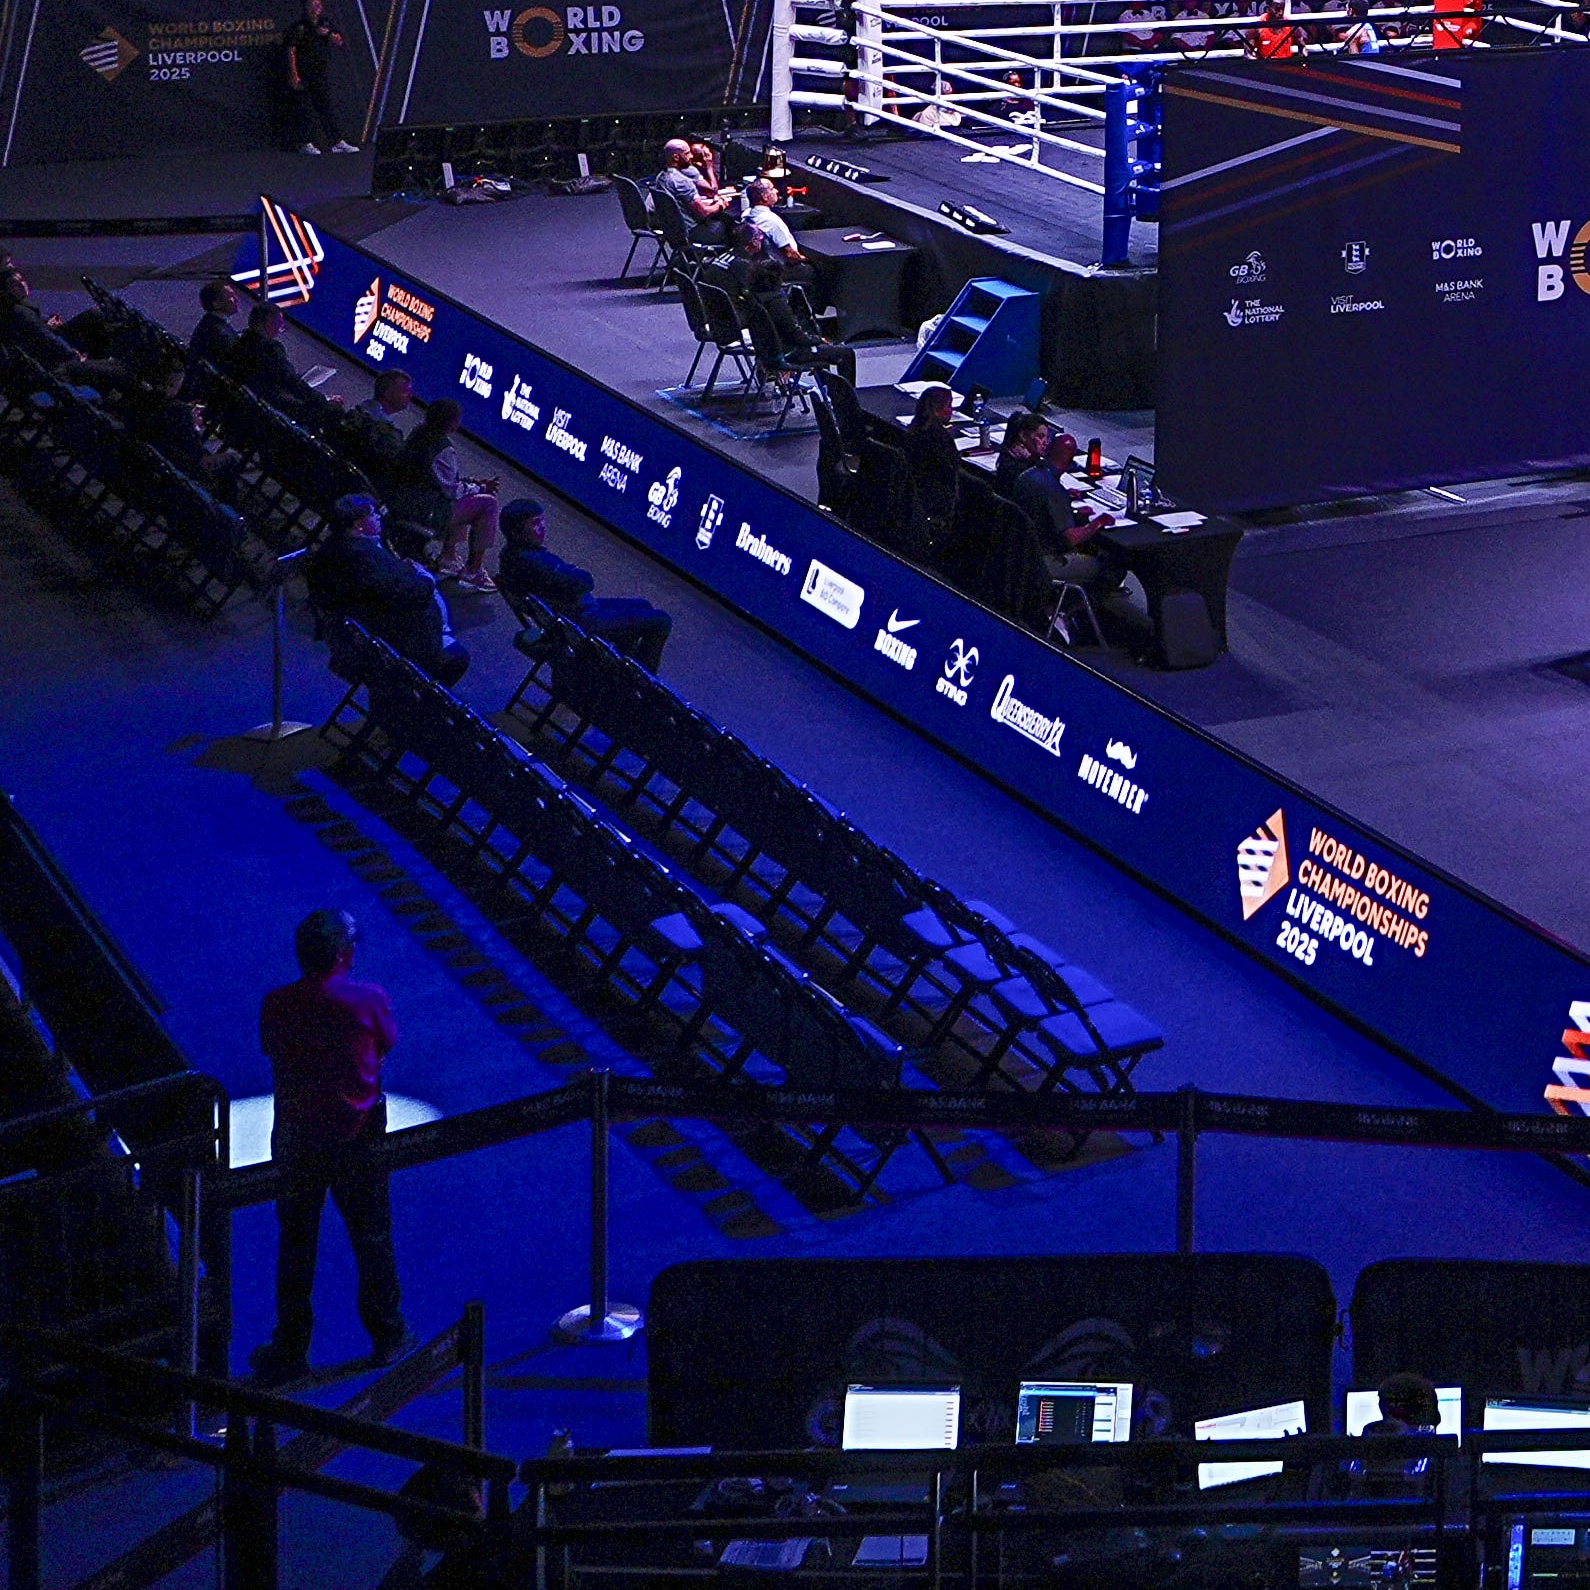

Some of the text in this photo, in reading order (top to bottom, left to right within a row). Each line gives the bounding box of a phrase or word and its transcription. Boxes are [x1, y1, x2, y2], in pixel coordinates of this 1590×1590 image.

[213, 19, 275, 32] BOXING
[148, 50, 243, 66] LIVERPOOL
[149, 68, 191, 81] 2025
[1229, 265, 1248, 277] GB
[1435, 279, 1484, 293] M&S BANK
[1244, 299, 1261, 308] THE
[1331, 295, 1354, 306] VISIT
[1443, 291, 1476, 303] ARENA
[1244, 305, 1285, 316] NATIONAL
[1330, 300, 1385, 314] LIVERPOOL
[1244, 314, 1281, 325] LOTTERY
[1077, 753, 1146, 814] MOVEMBER
[1309, 826, 1430, 920] WORLD BOXING
[1298, 859, 1429, 958] CHAMPIONSHIPS
[1286, 888, 1375, 966] LIVERPOOL
[1276, 920, 1319, 966] 2025
